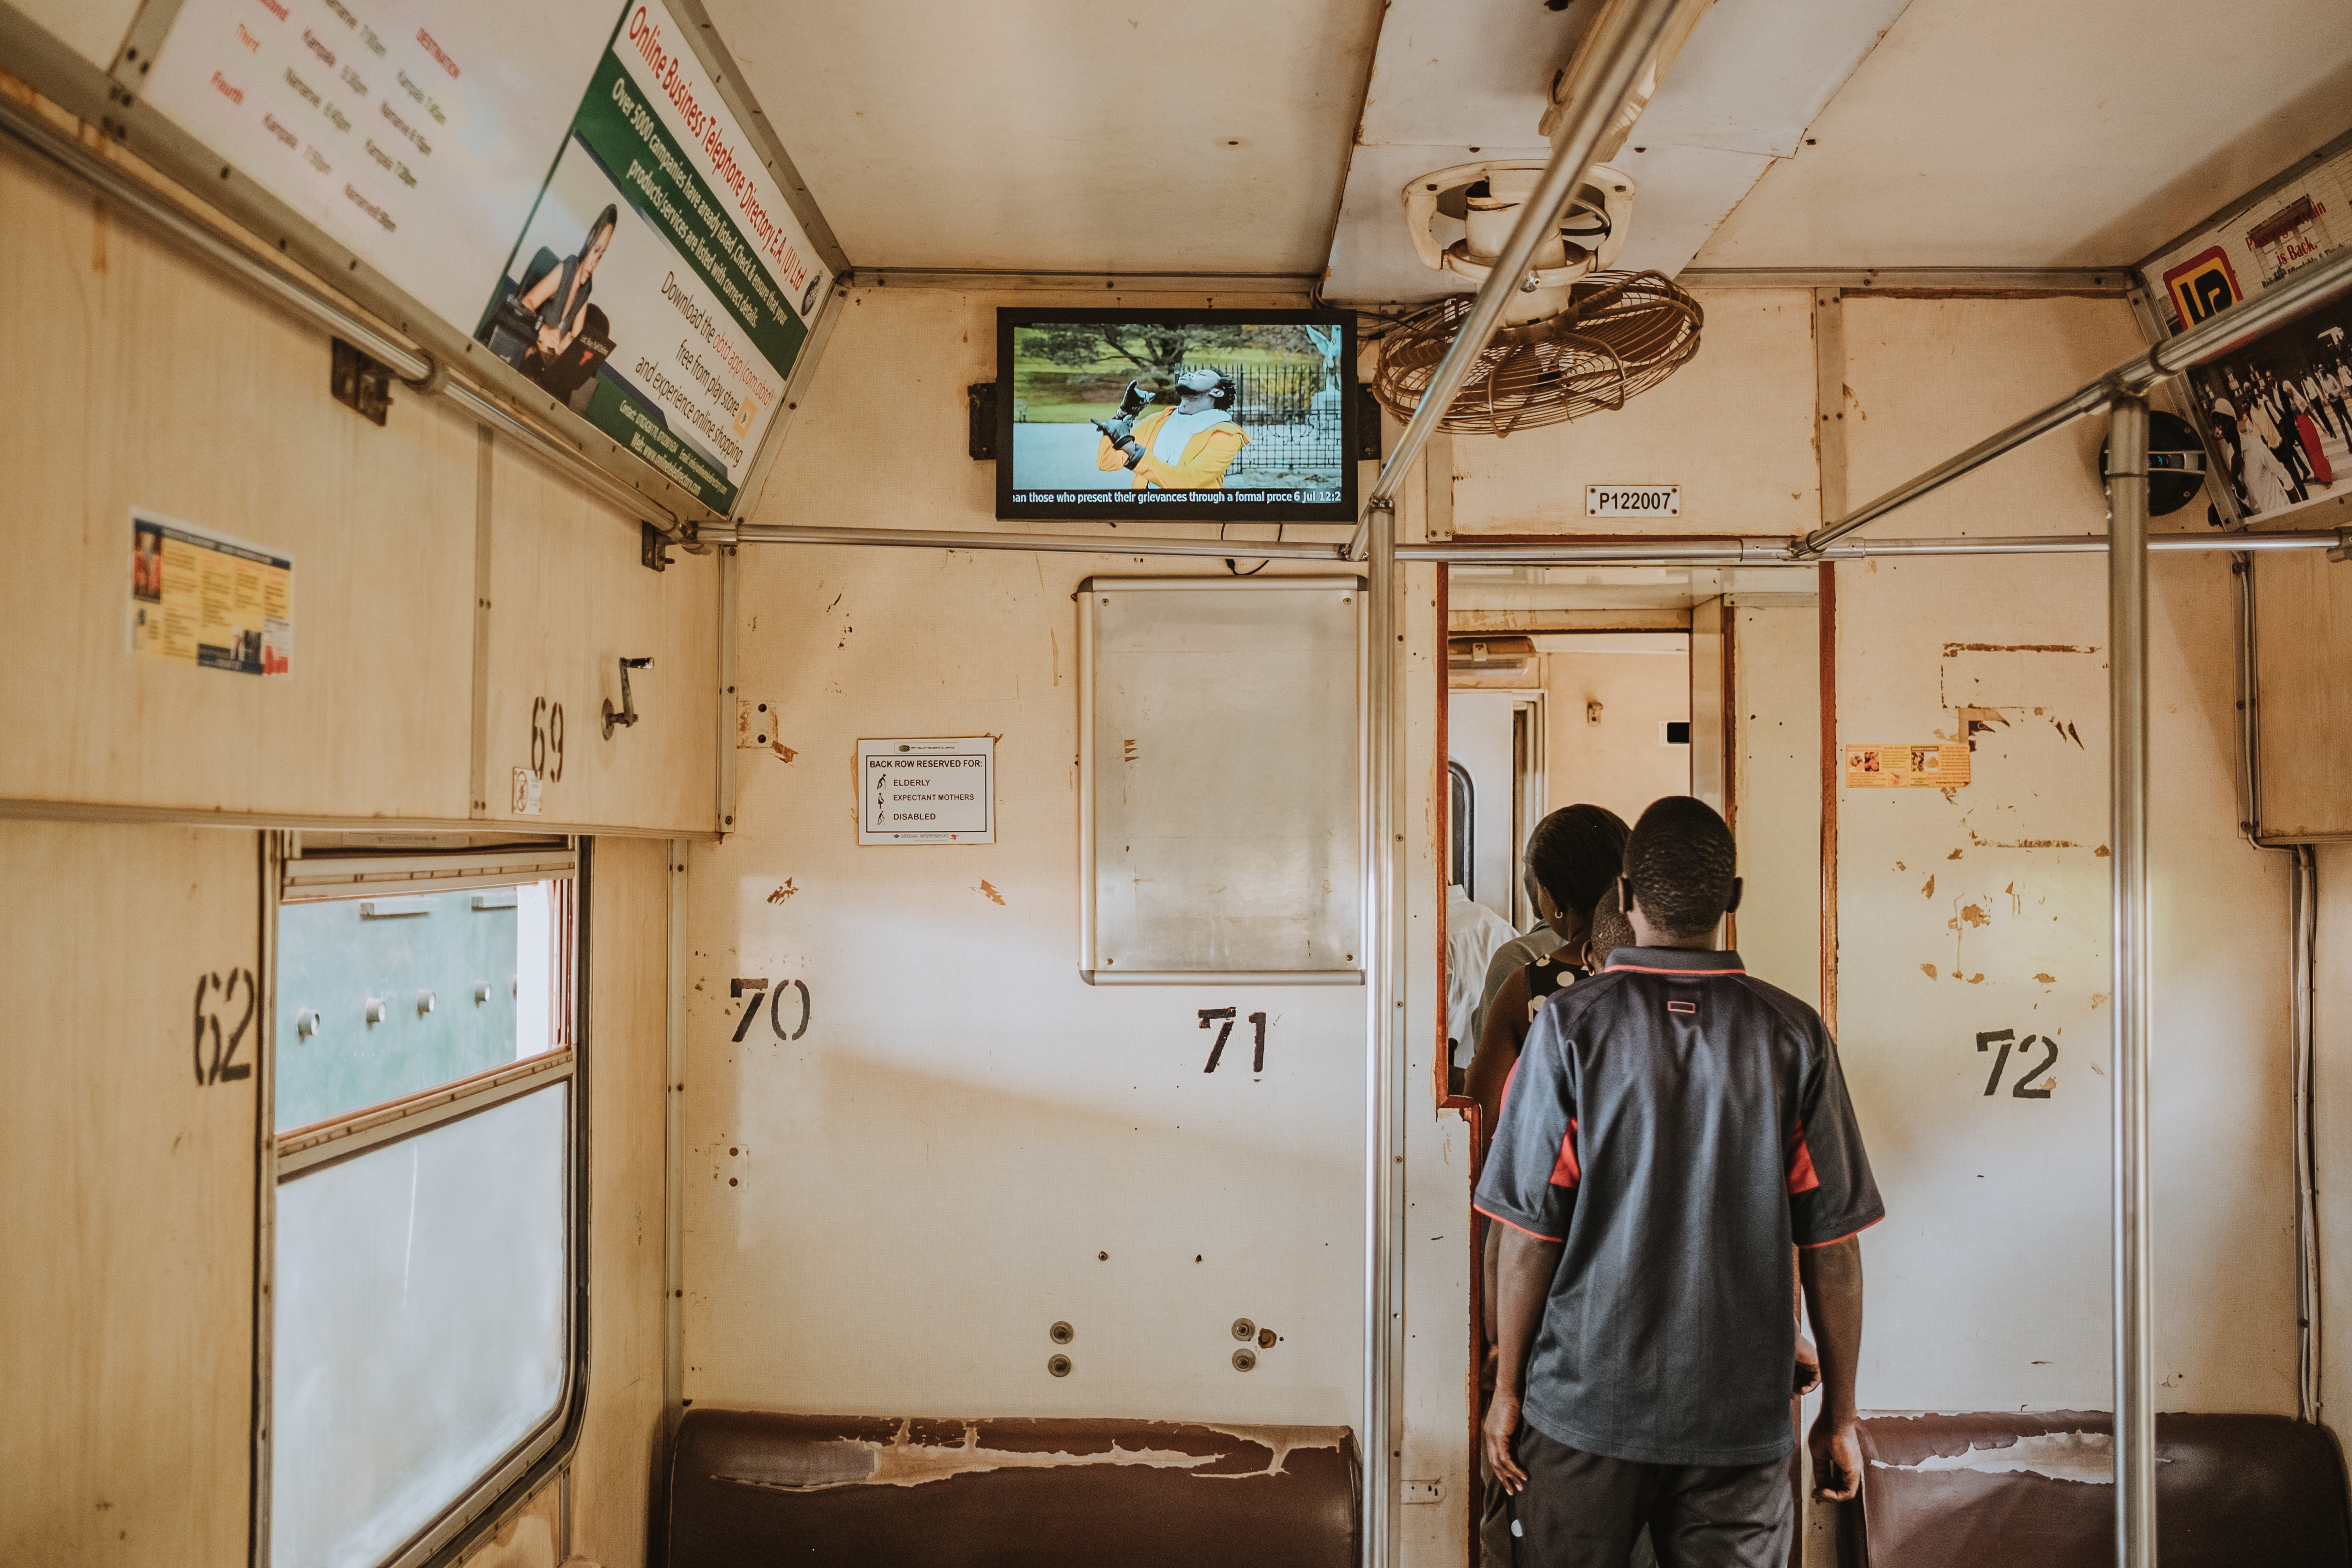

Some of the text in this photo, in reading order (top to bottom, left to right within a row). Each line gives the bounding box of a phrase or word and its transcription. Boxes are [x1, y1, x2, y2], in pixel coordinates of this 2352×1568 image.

[630, 6, 807, 292] Online Business Telephone Directory E.A. (U) Ltd
[613, 78, 634, 116] Over
[630, 104, 653, 141] 5000
[649, 135, 686, 187] campanies
[683, 174, 700, 208] have
[698, 200, 720, 237] aready
[717, 221, 737, 253] listed
[748, 264, 755, 281] &
[752, 274, 769, 301] ensure
[767, 291, 778, 313] that
[773, 306, 787, 325] your
[627, 160, 757, 328] products/services are listed with correct details.
[2275, 251, 2288, 266] is
[2287, 236, 2318, 261] Back.
[661, 271, 774, 410] Download the obtd app (com.obtd)
[620, 400, 636, 420] Contact:
[635, 357, 742, 467] and experience online shopping
[676, 339, 738, 416] free from play store
[631, 432, 700, 495] Web: www.onlineteledirectory.com
[1029, 492, 1054, 502] those
[1057, 492, 1076, 502] who
[1077, 493, 1112, 504] present
[1114, 492, 1136, 502] their
[1138, 492, 1186, 504] grievances
[1189, 491, 1225, 504] through
[1227, 493, 1233, 502] a
[1235, 491, 1265, 502] formal
[1267, 493, 1292, 504] proce
[1293, 491, 1341, 503] 6 Jul 12:2
[1600, 492, 1671, 509] P122007
[531, 696, 564, 783] 69
[194, 968, 254, 1086] 62
[731, 978, 811, 1043] 70
[1198, 1007, 1266, 1073] 71
[1976, 1029, 2058, 1098] 72
